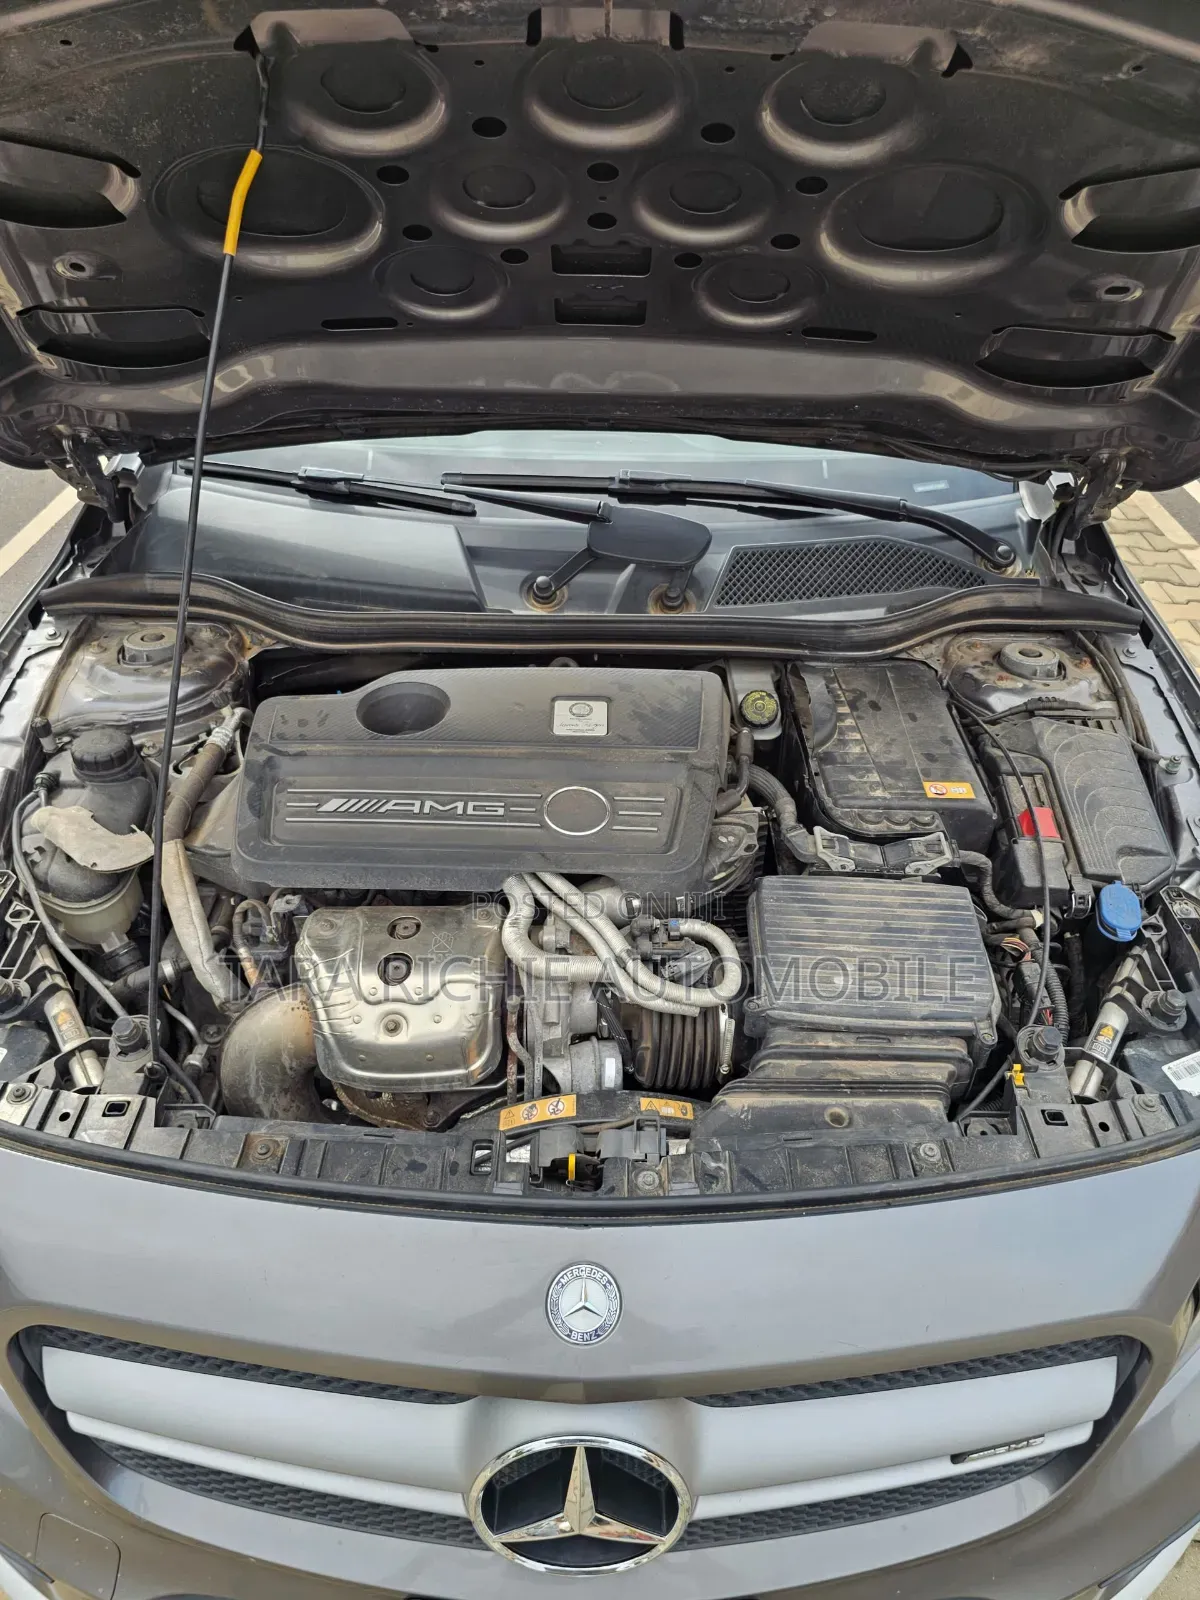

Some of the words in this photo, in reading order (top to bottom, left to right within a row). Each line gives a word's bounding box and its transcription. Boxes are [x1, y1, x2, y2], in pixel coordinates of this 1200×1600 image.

[377, 799, 506, 817] AMG
[560, 1267, 608, 1285] MERCEDES
[571, 1331, 598, 1343] BENZ
